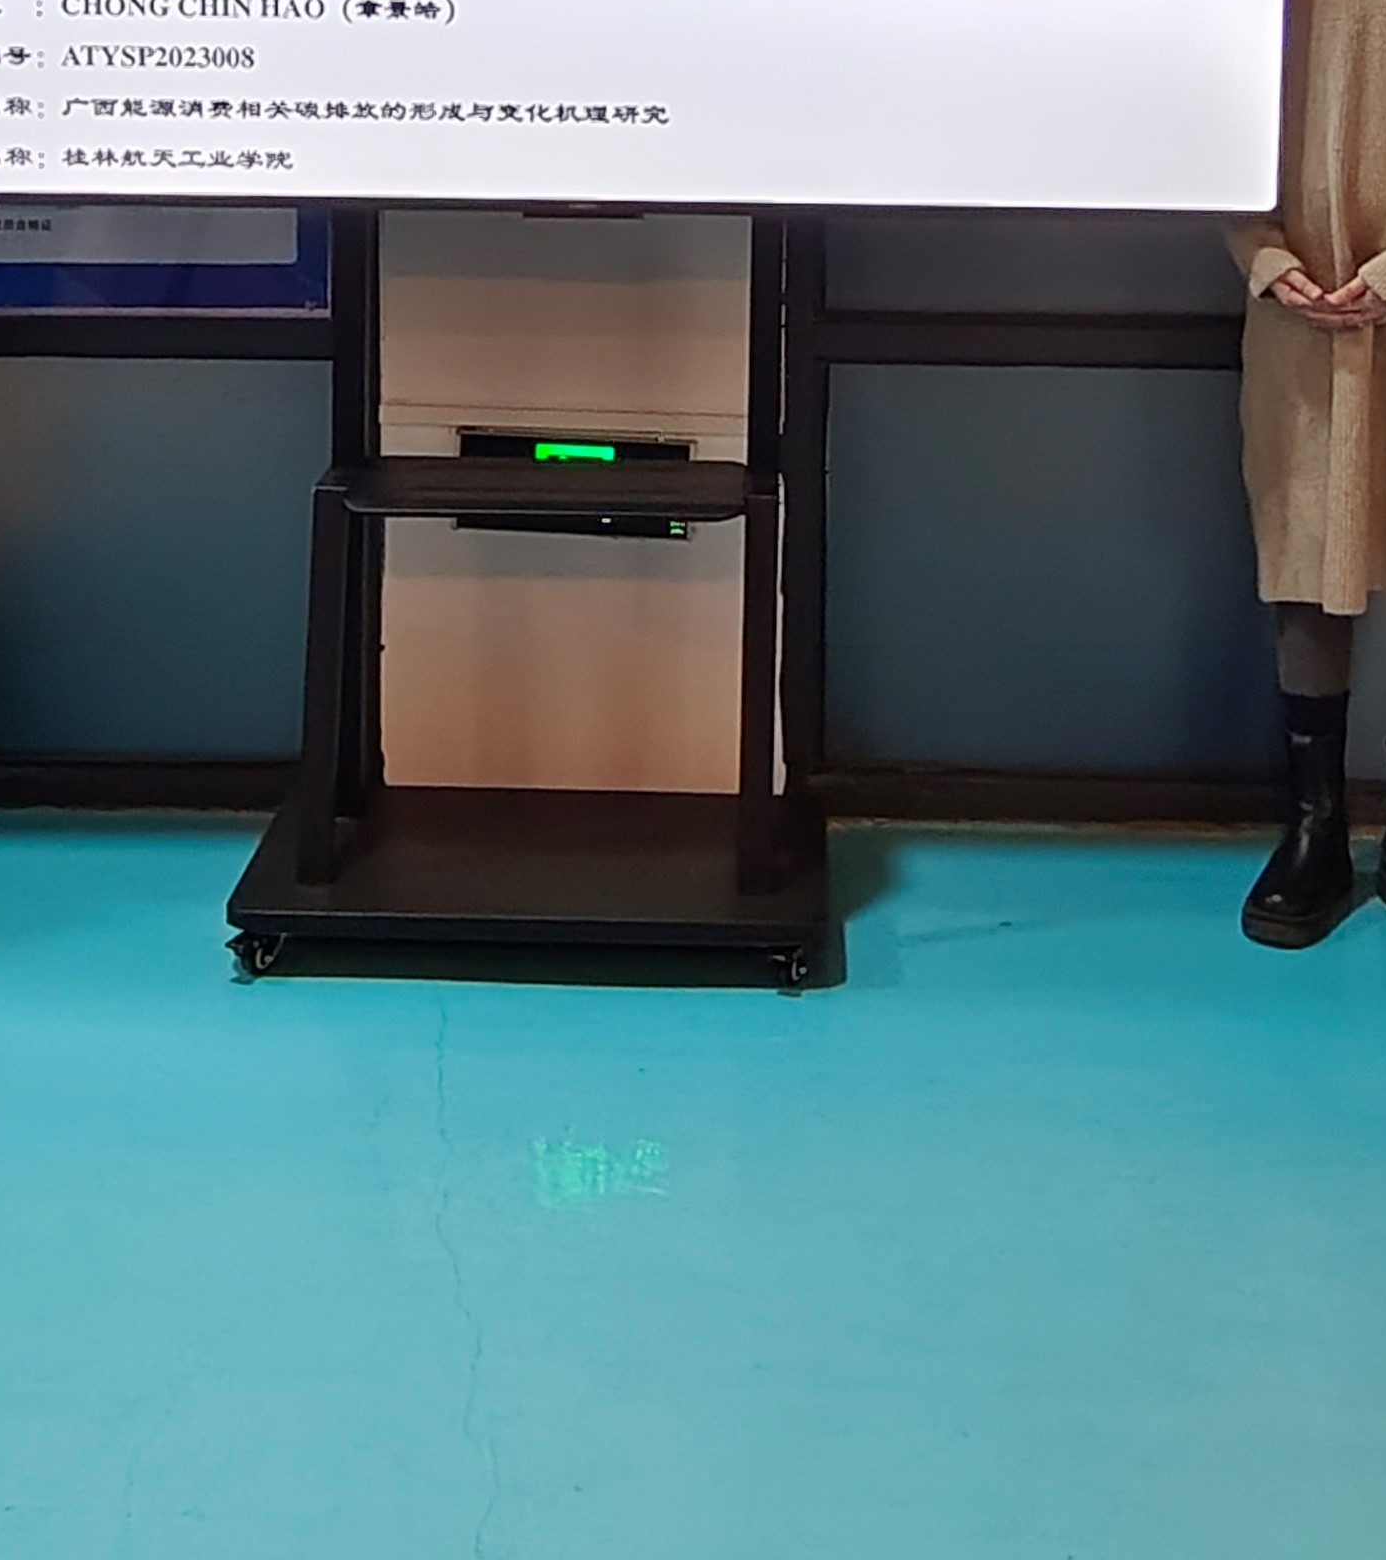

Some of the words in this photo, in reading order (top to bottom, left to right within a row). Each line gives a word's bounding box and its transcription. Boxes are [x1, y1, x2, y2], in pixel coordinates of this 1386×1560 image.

[62, 45, 256, 69] ATYSP2023008
[62, 98, 669, 124] 广西能源消费相关碳排放的形成与变化机理研究
[62, 148, 294, 170] 桂林航天工业学院
